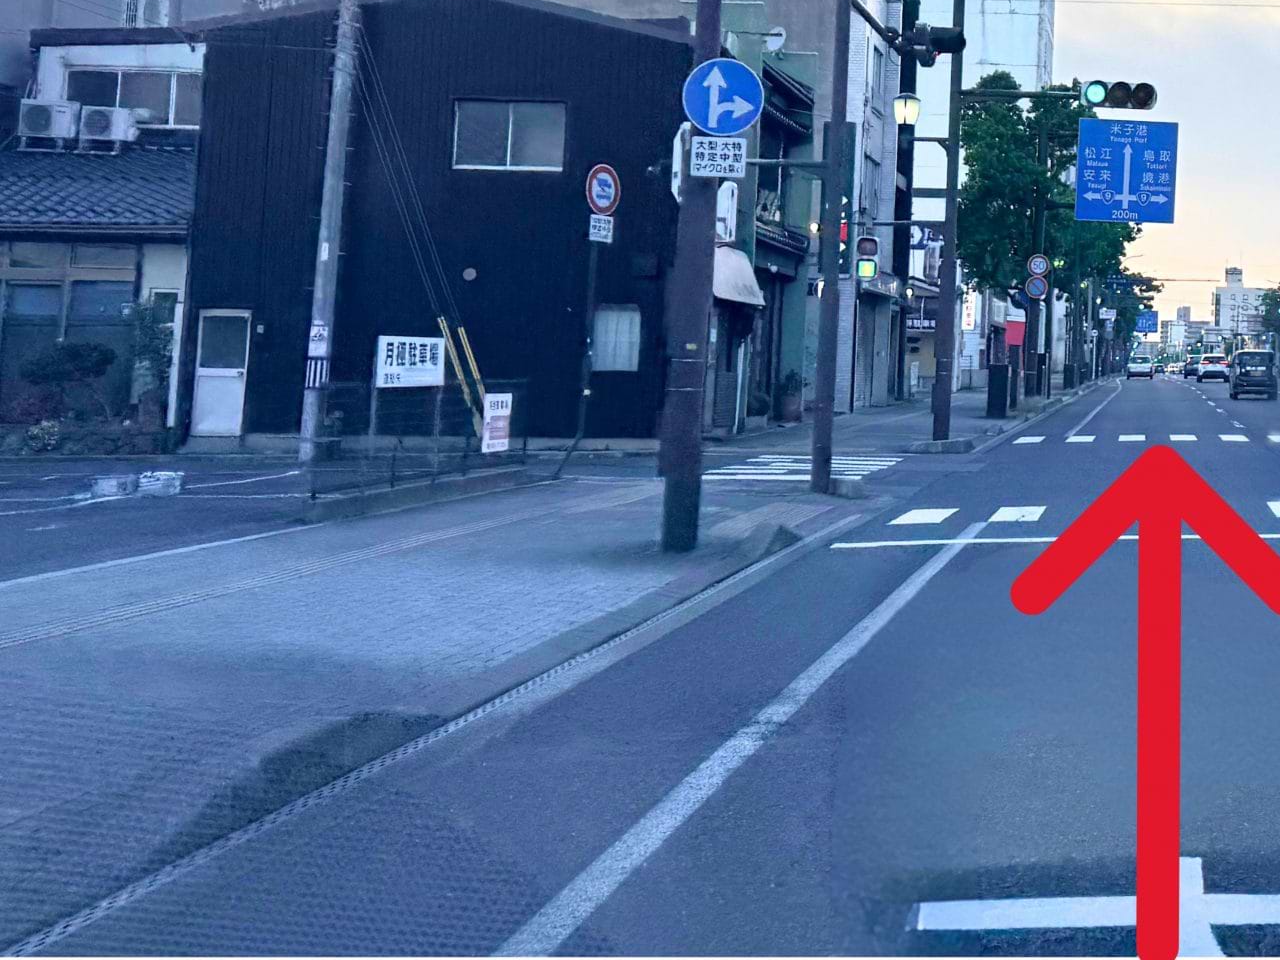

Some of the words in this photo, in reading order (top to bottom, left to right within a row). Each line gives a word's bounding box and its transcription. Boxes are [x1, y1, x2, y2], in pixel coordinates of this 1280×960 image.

[1110, 123, 1148, 136] 米子港
[1084, 147, 1112, 159] 松江
[1143, 150, 1171, 162] 鳥取
[1083, 169, 1112, 182] 安来
[1105, 192, 1111, 200] 9
[1140, 193, 1147, 202] 9
[1112, 210, 1138, 220] 200m
[1033, 260, 1045, 270] 50
